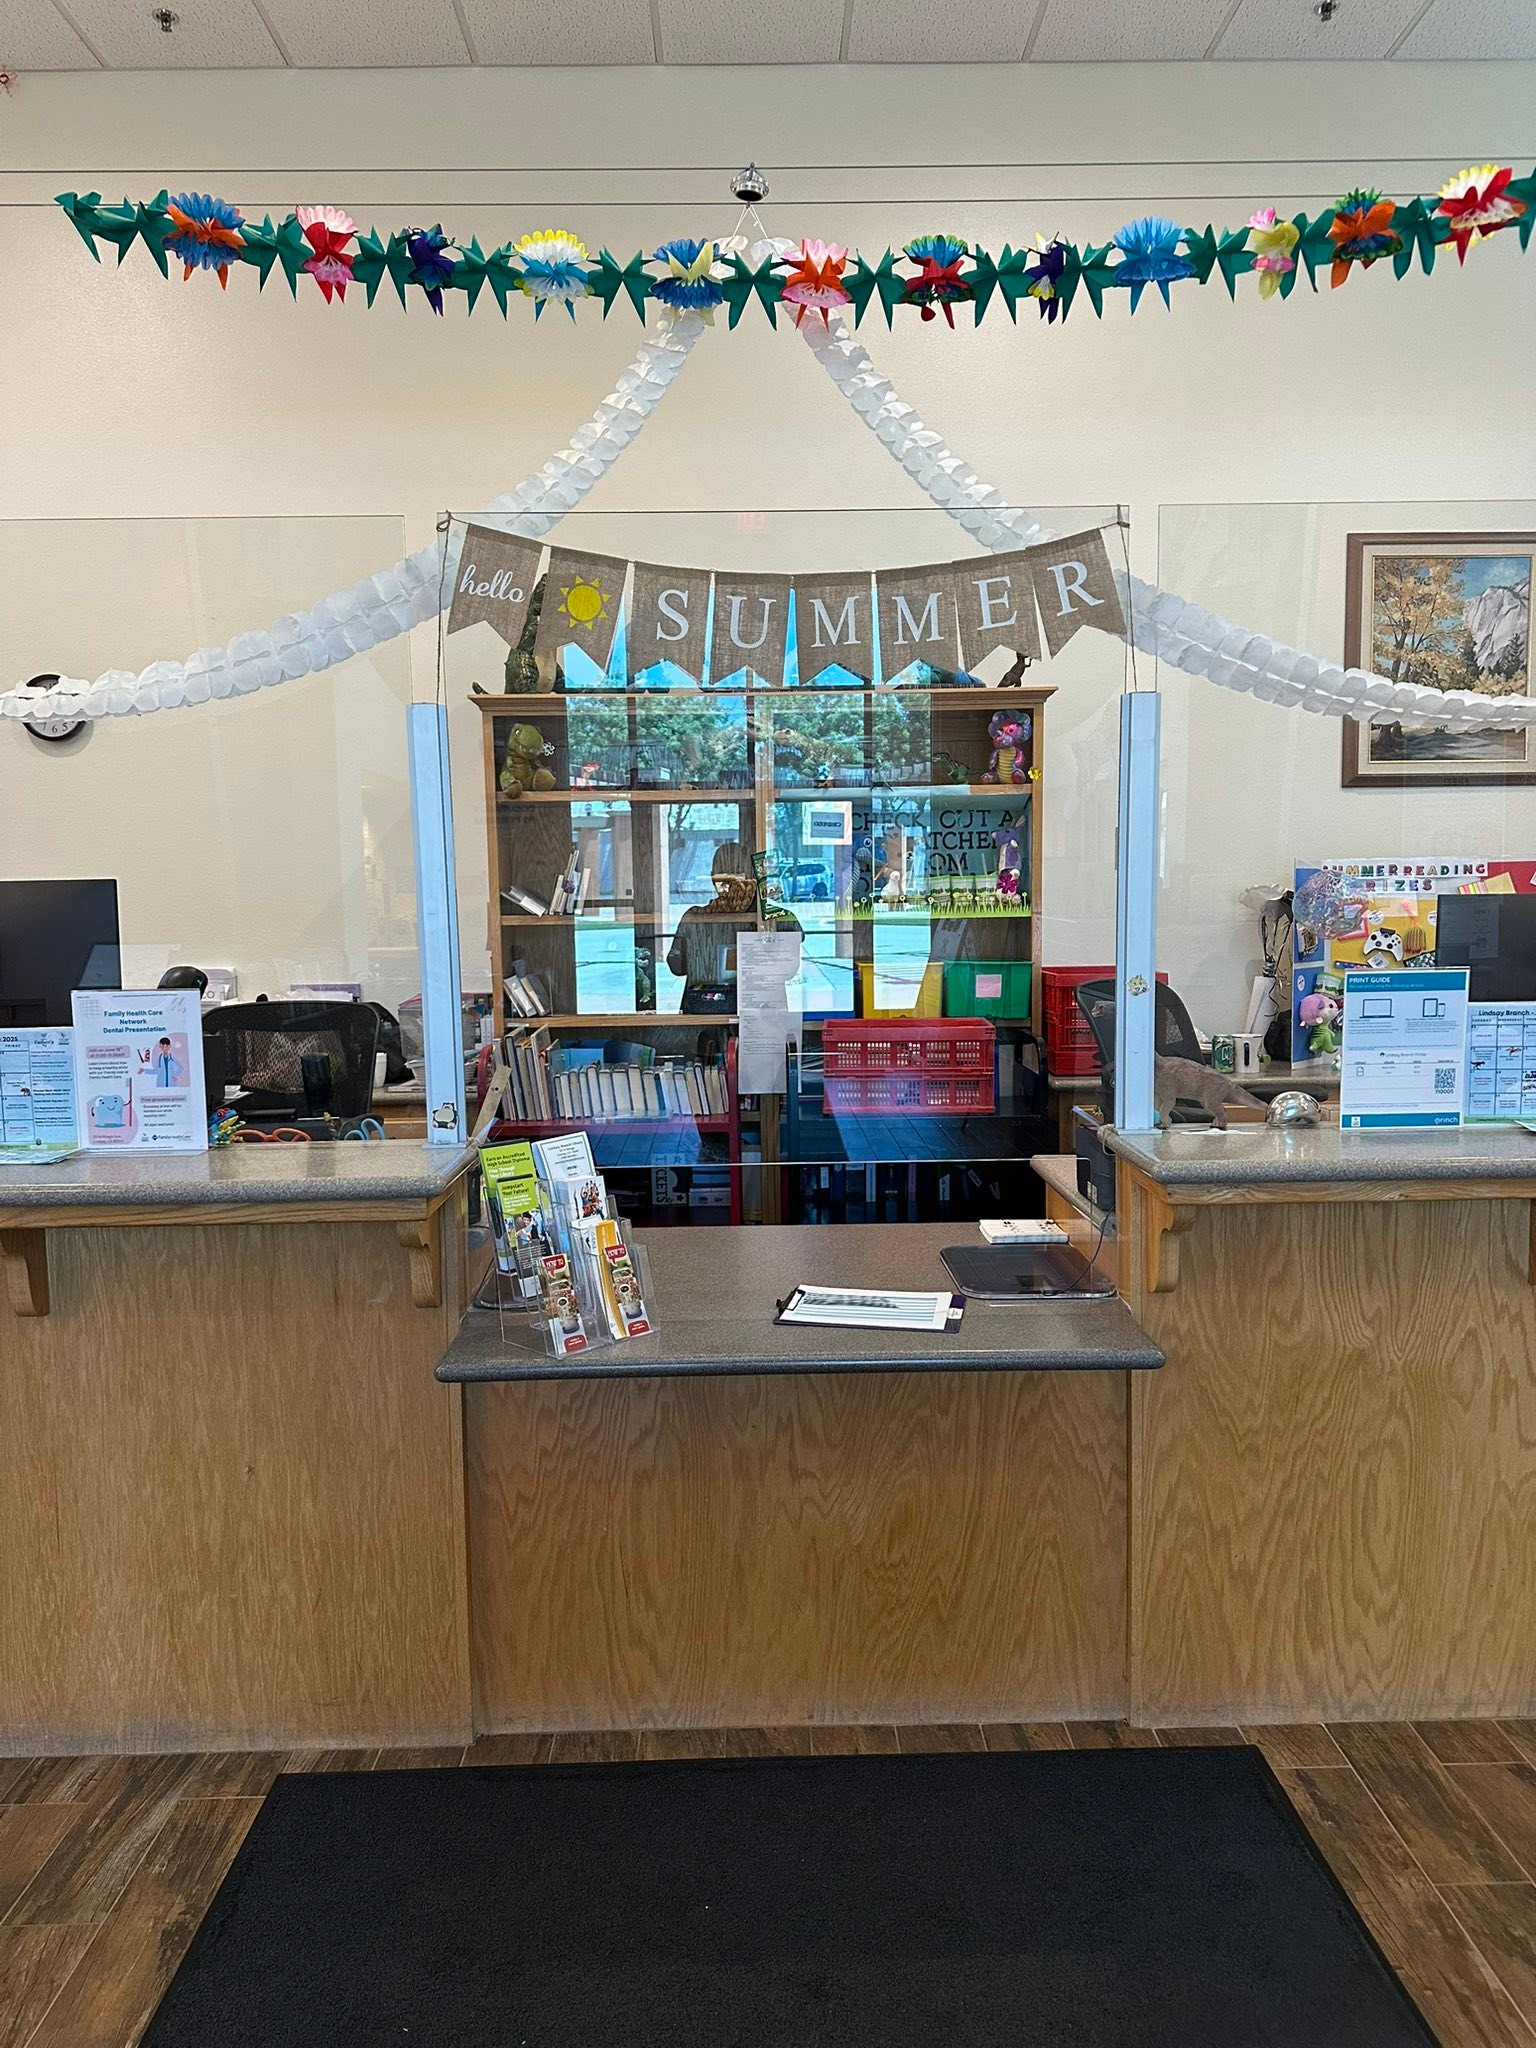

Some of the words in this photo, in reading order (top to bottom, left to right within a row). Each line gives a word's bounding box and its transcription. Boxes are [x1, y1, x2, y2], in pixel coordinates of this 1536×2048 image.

[459, 564, 526, 604] hello
[656, 560, 1105, 650] SUMMER
[52, 724, 58, 734] 6
[62, 722, 69, 732] 5
[851, 811, 927, 831] CHECK
[939, 809, 990, 829] OUT
[998, 809, 1014, 828] A
[1403, 864, 1486, 876] READING
[1365, 878, 1433, 892] RIZES
